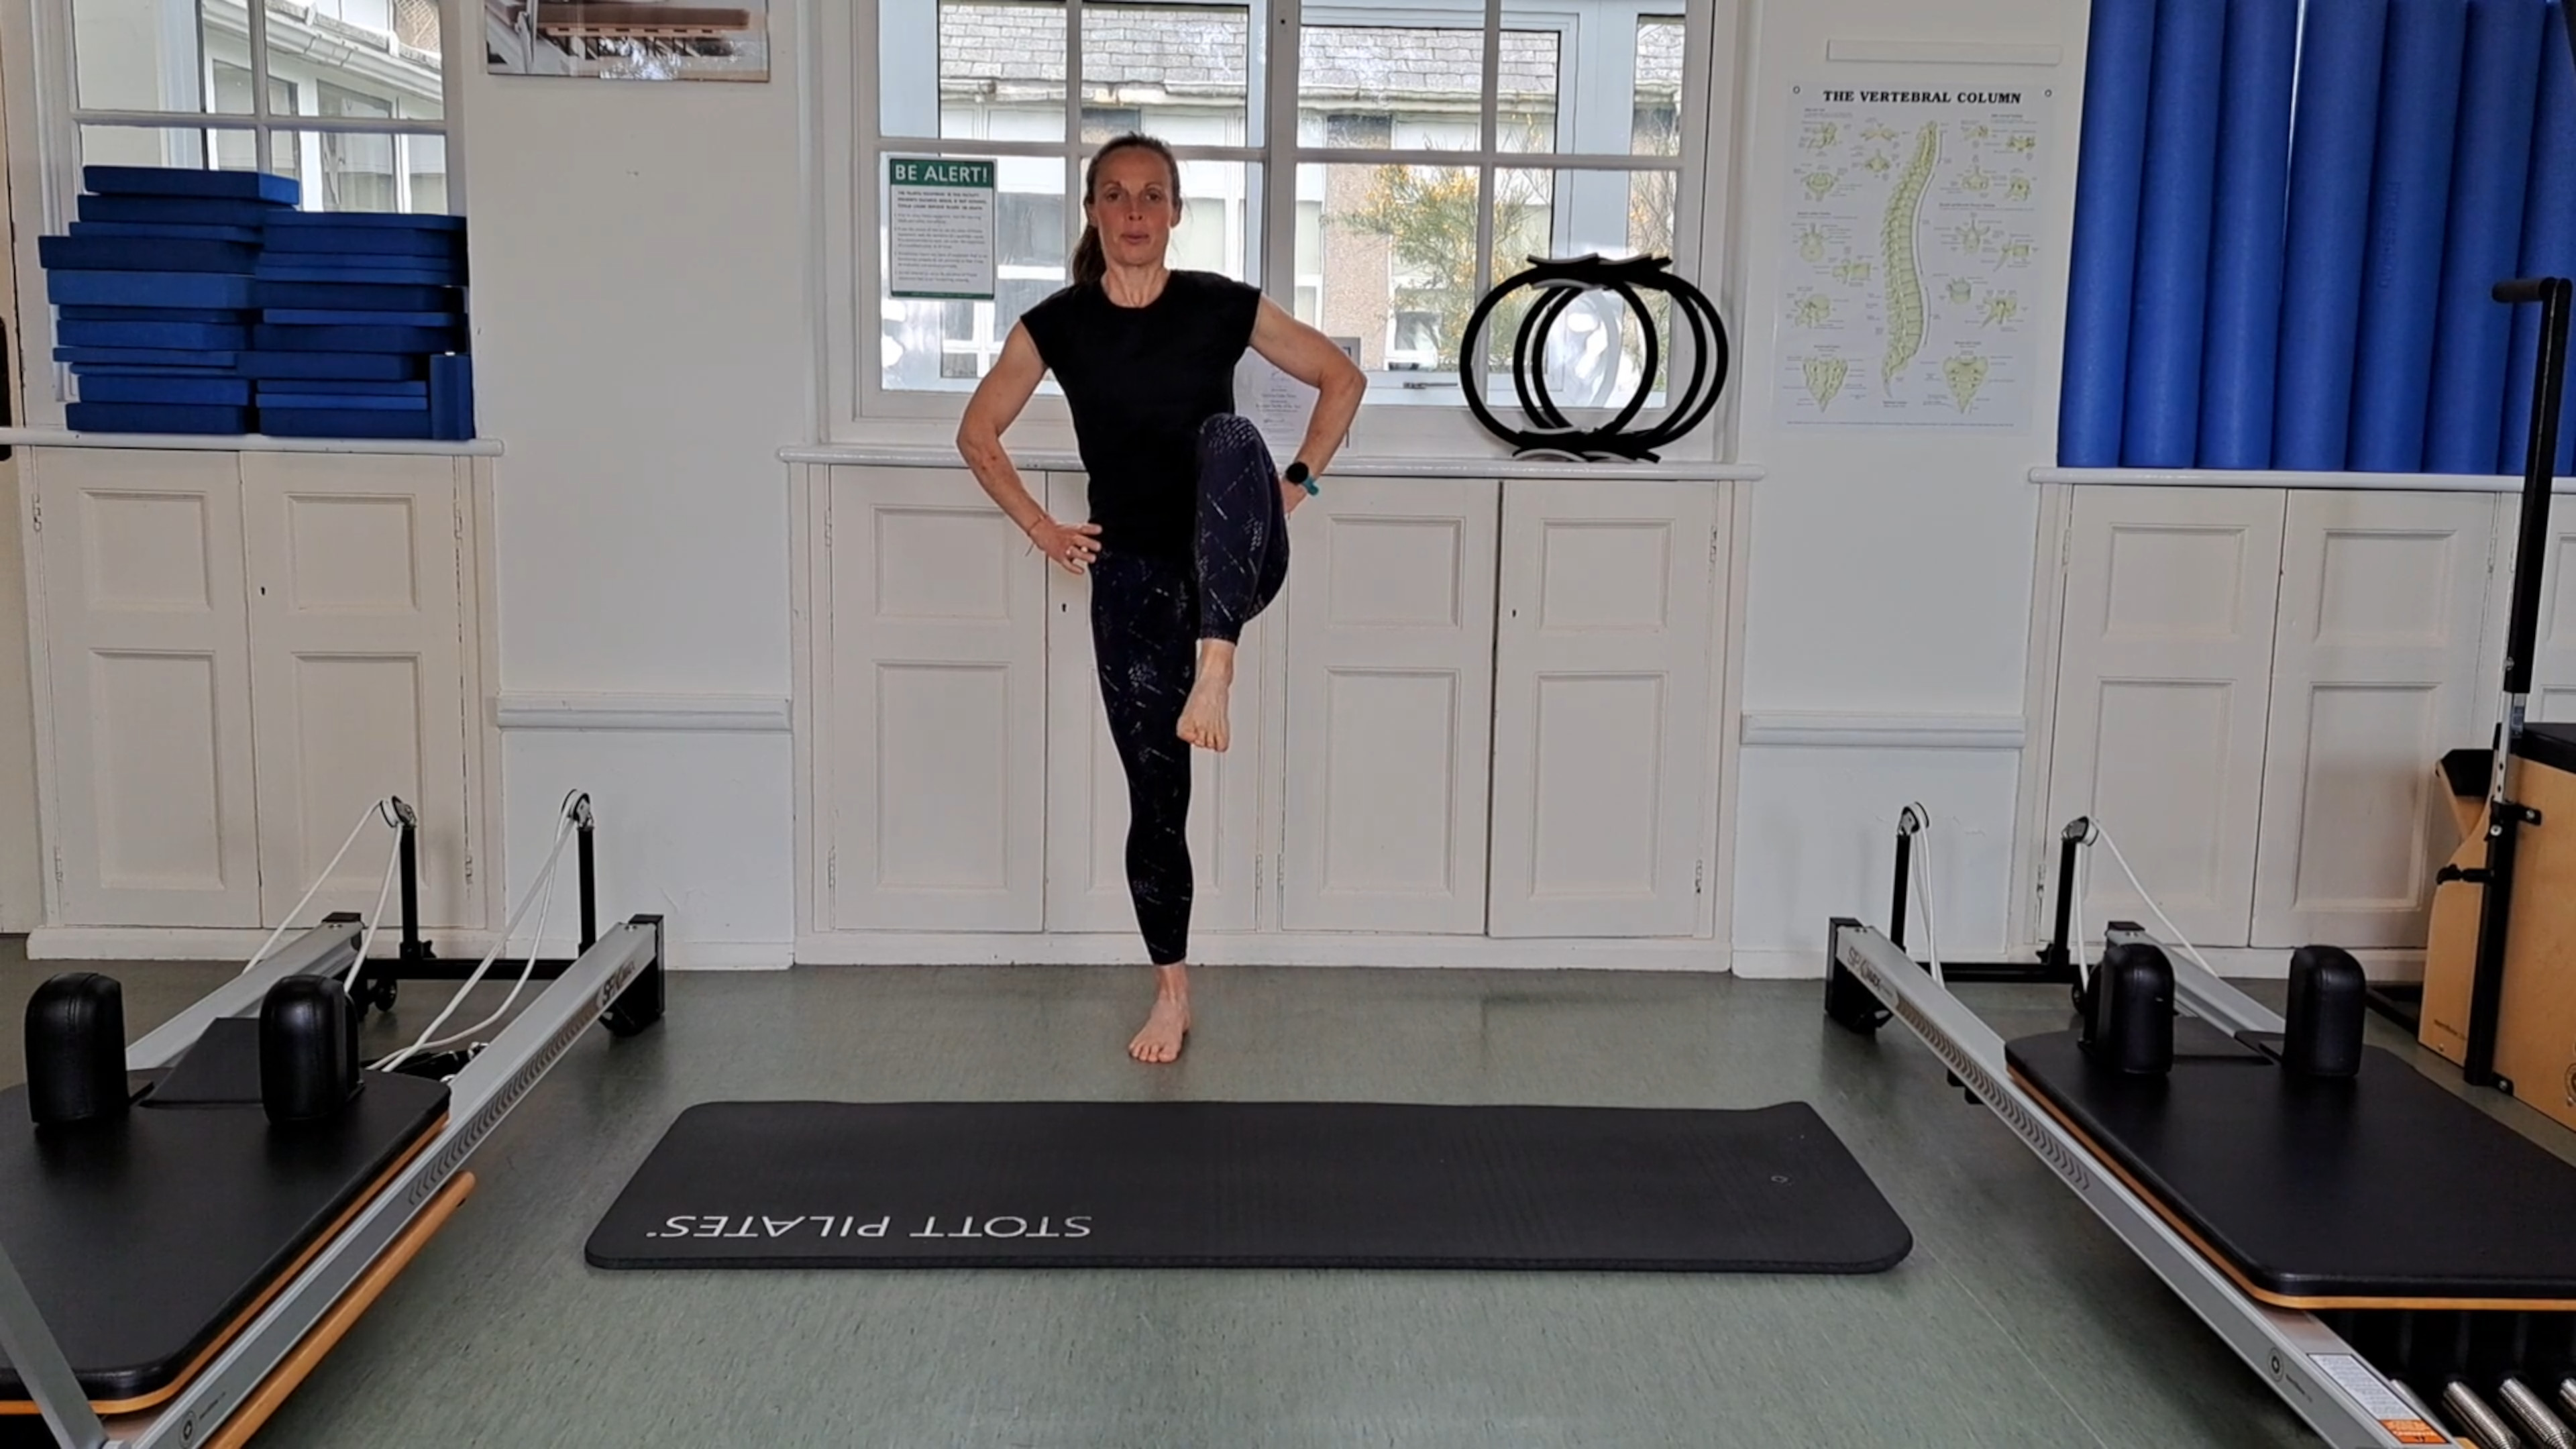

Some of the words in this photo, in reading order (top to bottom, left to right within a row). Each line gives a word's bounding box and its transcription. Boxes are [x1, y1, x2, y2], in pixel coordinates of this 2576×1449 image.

[1823, 91, 1854, 102] THE
[1860, 91, 1951, 103] VERTEBRAL
[1957, 92, 2021, 104] COLUMN
[896, 164, 917, 181] BE
[924, 166, 987, 183] ALERT!
[909, 1215, 1092, 1238] STOTT
